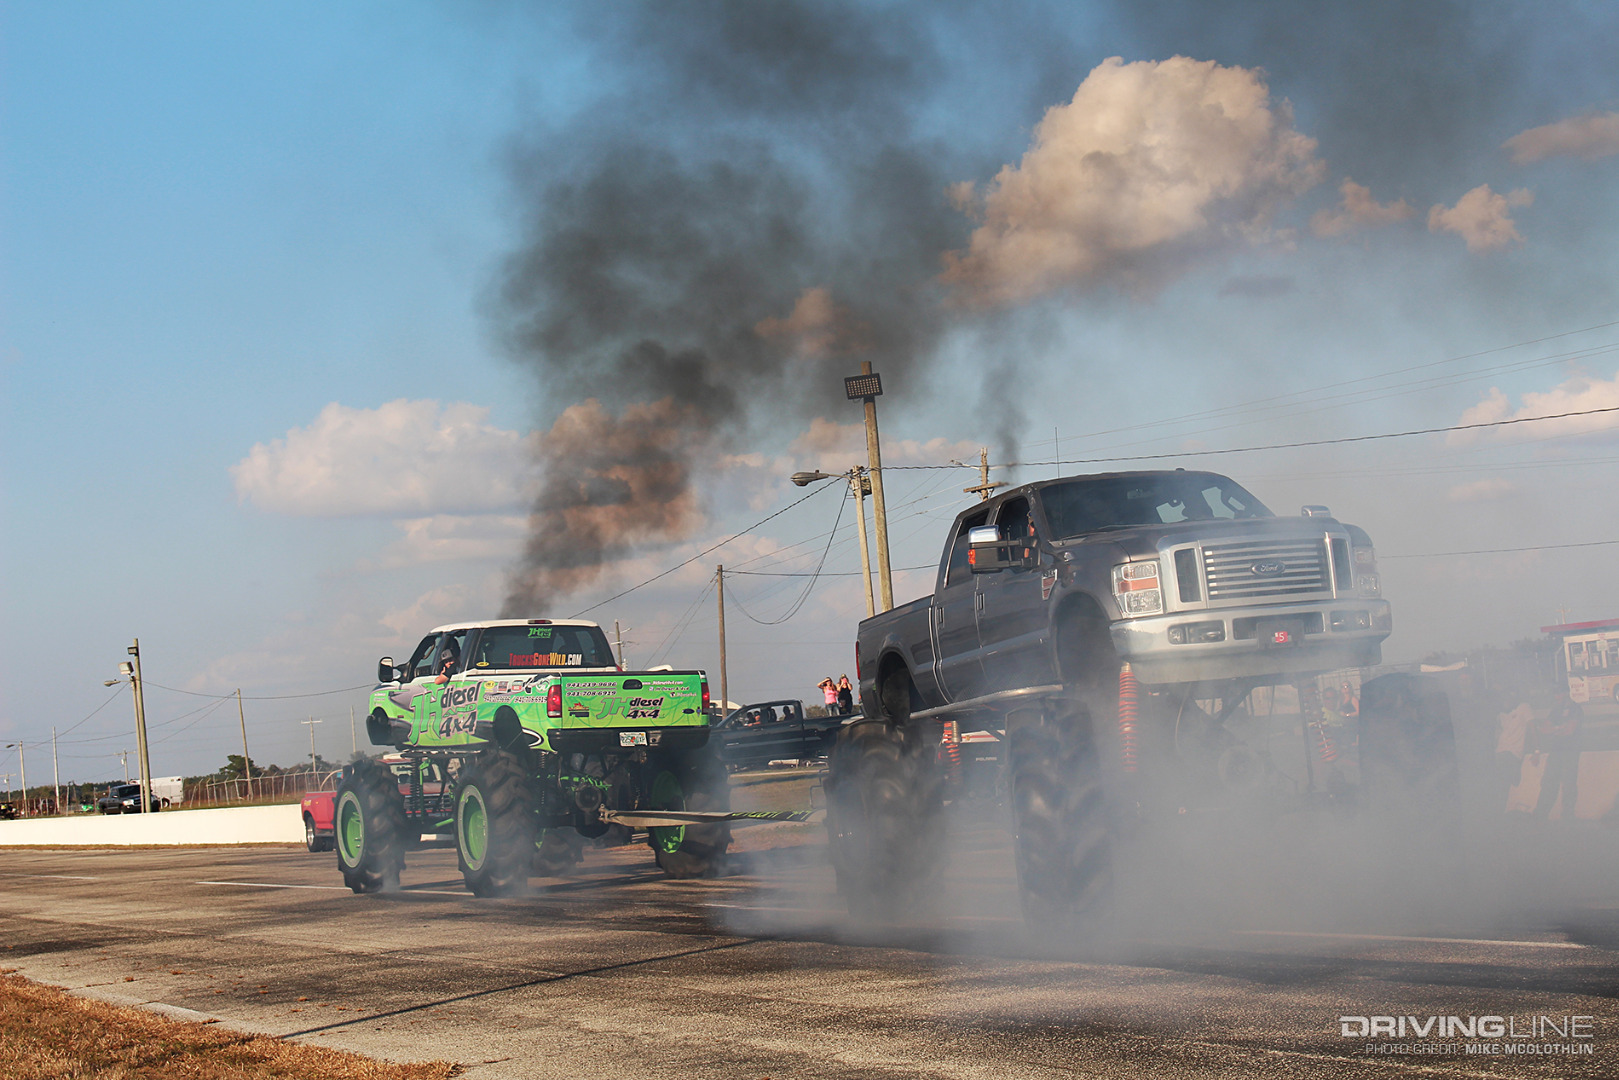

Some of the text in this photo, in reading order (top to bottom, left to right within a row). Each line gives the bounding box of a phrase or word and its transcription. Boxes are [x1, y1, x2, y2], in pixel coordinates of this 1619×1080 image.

[408, 680, 482, 746] JH diesel
[596, 697, 634, 719] JH
[629, 697, 664, 707] diesel
[626, 709, 660, 719] 4x4
[440, 711, 477, 738] 4x4
